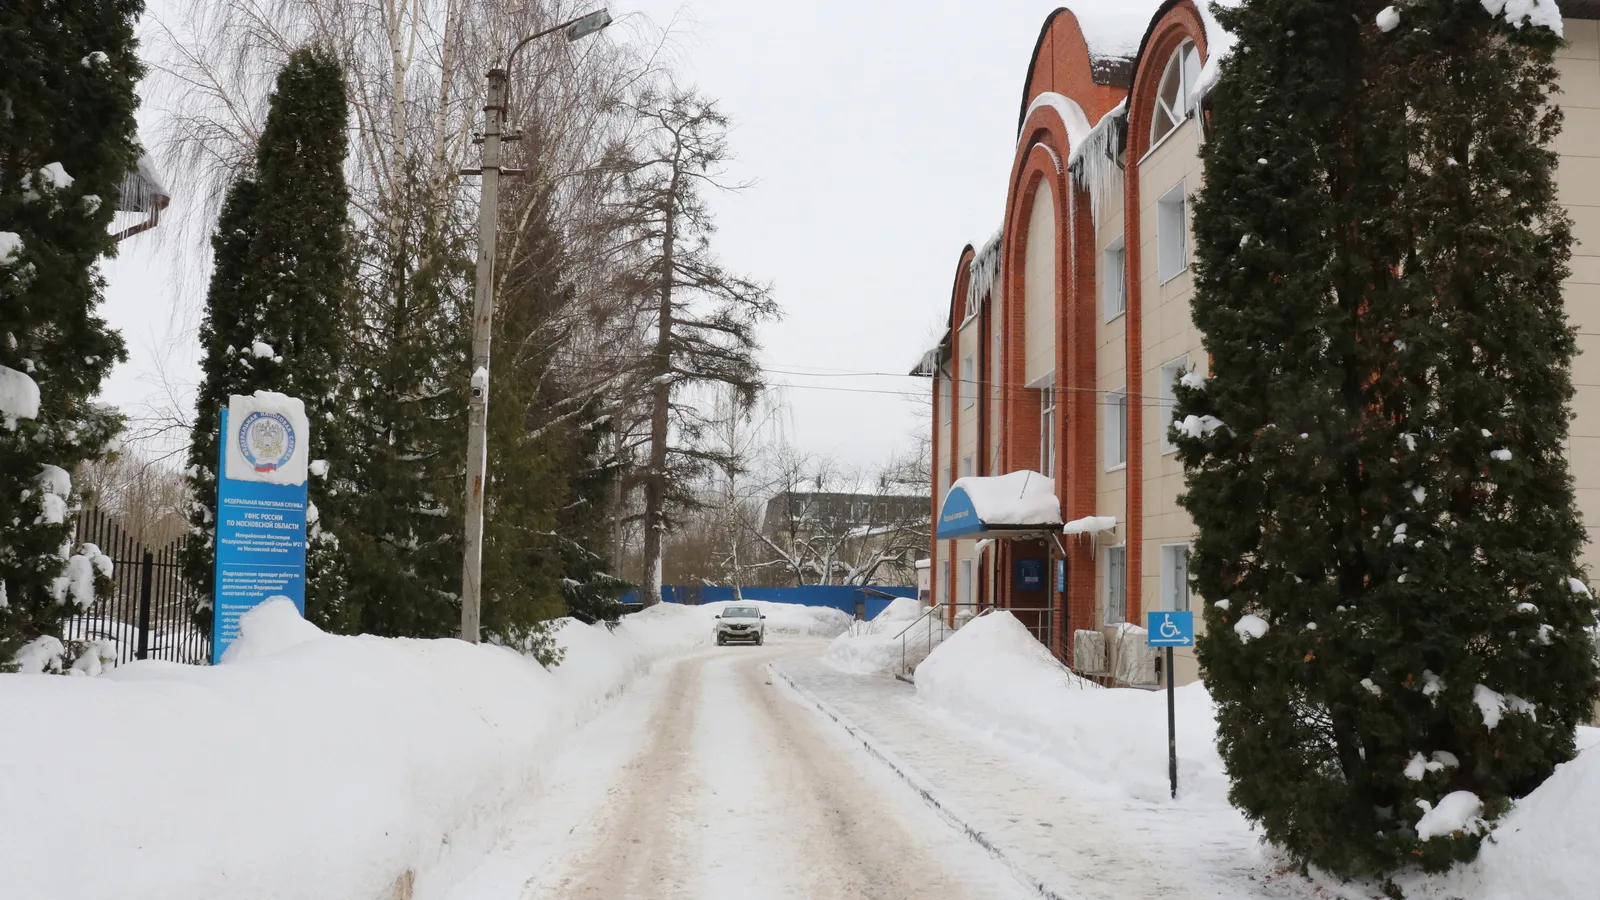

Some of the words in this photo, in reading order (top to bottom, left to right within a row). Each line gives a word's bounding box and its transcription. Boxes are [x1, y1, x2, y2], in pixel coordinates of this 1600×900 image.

[224, 497, 257, 505] ФЕДЕРАЛЬНАЯ
[261, 513, 283, 521] РОССИИ
[236, 520, 273, 529] МОСКОВСКОЙ
[274, 522, 299, 530] ОБЛАСТИ
